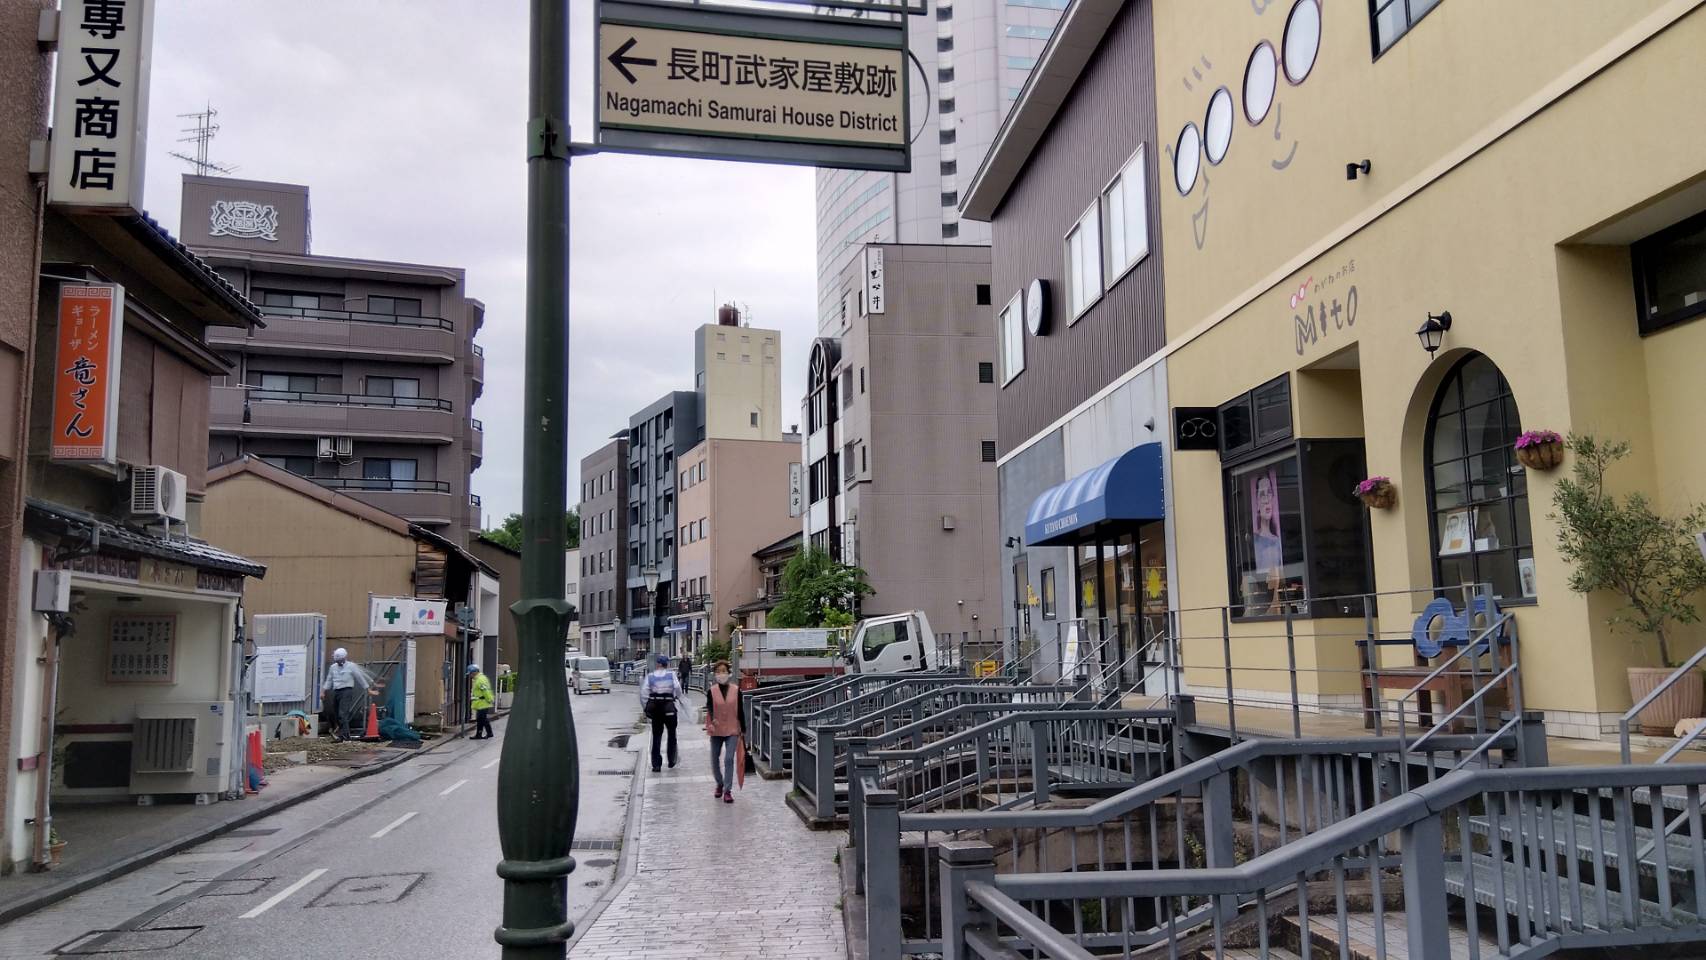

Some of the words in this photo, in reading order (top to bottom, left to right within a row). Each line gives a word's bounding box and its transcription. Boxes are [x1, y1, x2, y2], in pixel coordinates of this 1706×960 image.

[69, 0, 127, 191] 専又商店
[667, 47, 898, 99] 長町武家屋敷跡
[606, 91, 702, 118] Nagamachi
[708, 100, 777, 124] Samurai
[782, 106, 834, 128] House
[840, 110, 898, 132] District
[68, 304, 85, 351] ギョーザ
[87, 304, 101, 352] ラーメン
[64, 356, 98, 439] 竜さん
